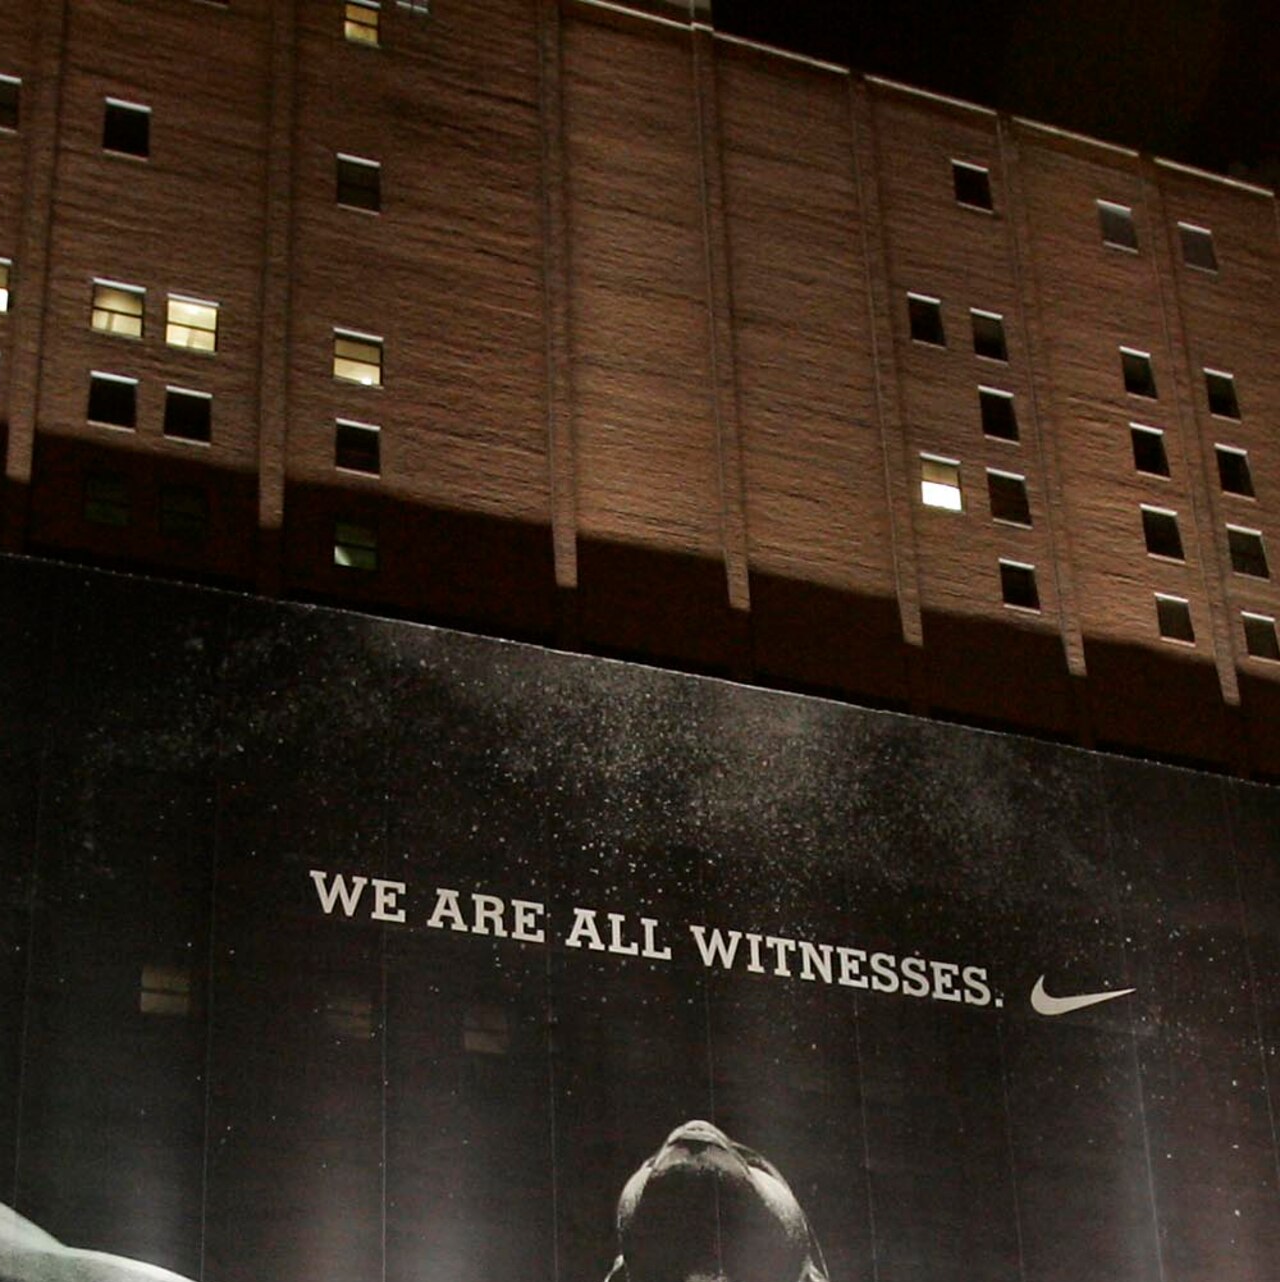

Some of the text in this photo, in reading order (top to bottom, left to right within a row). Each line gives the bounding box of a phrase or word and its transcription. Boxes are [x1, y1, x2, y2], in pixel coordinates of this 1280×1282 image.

[309, 869, 1005, 1009] WE ARE ALL WITNESSES.
